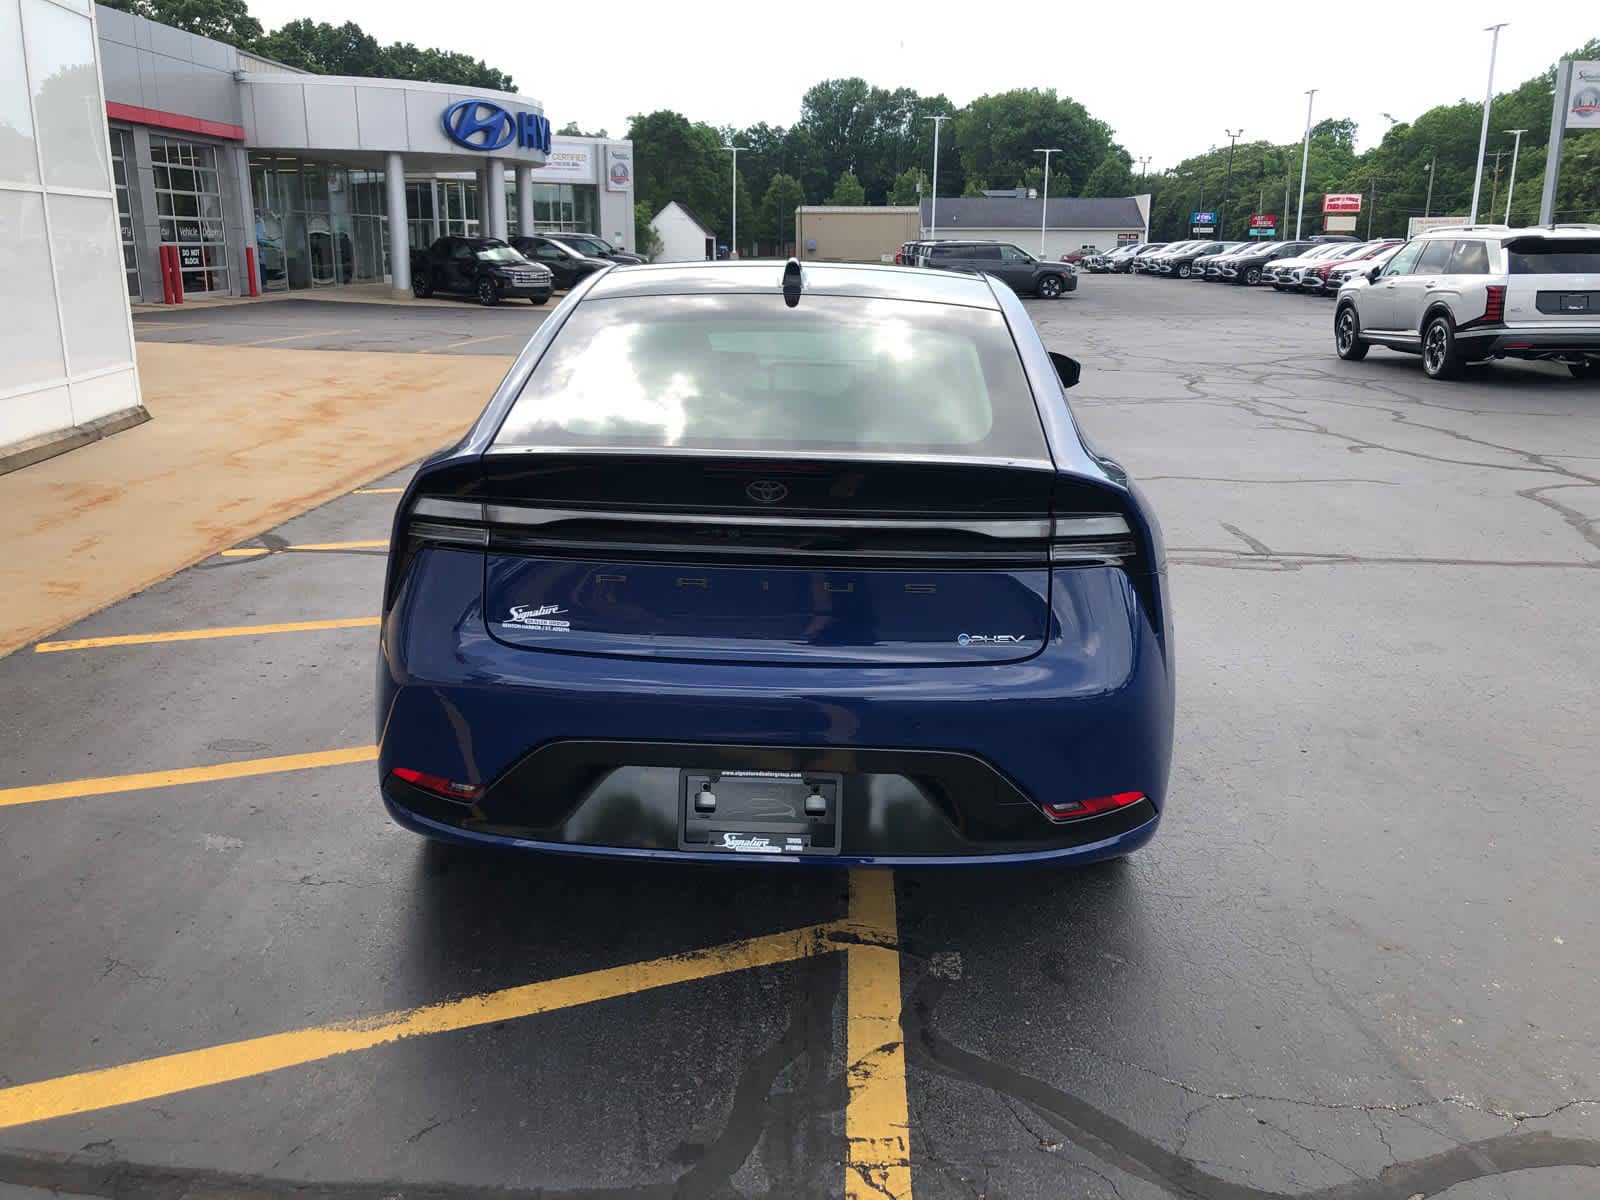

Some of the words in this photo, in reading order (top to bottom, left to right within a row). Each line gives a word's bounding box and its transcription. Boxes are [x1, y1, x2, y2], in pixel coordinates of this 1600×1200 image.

[179, 226, 198, 237] Vehicle
[182, 249, 190, 257] DO
[190, 249, 200, 257] NOT
[184, 257, 200, 265] BLOCK
[595, 574, 937, 594] PRIUS
[503, 604, 569, 623] Signature
[714, 832, 771, 849] Signature
